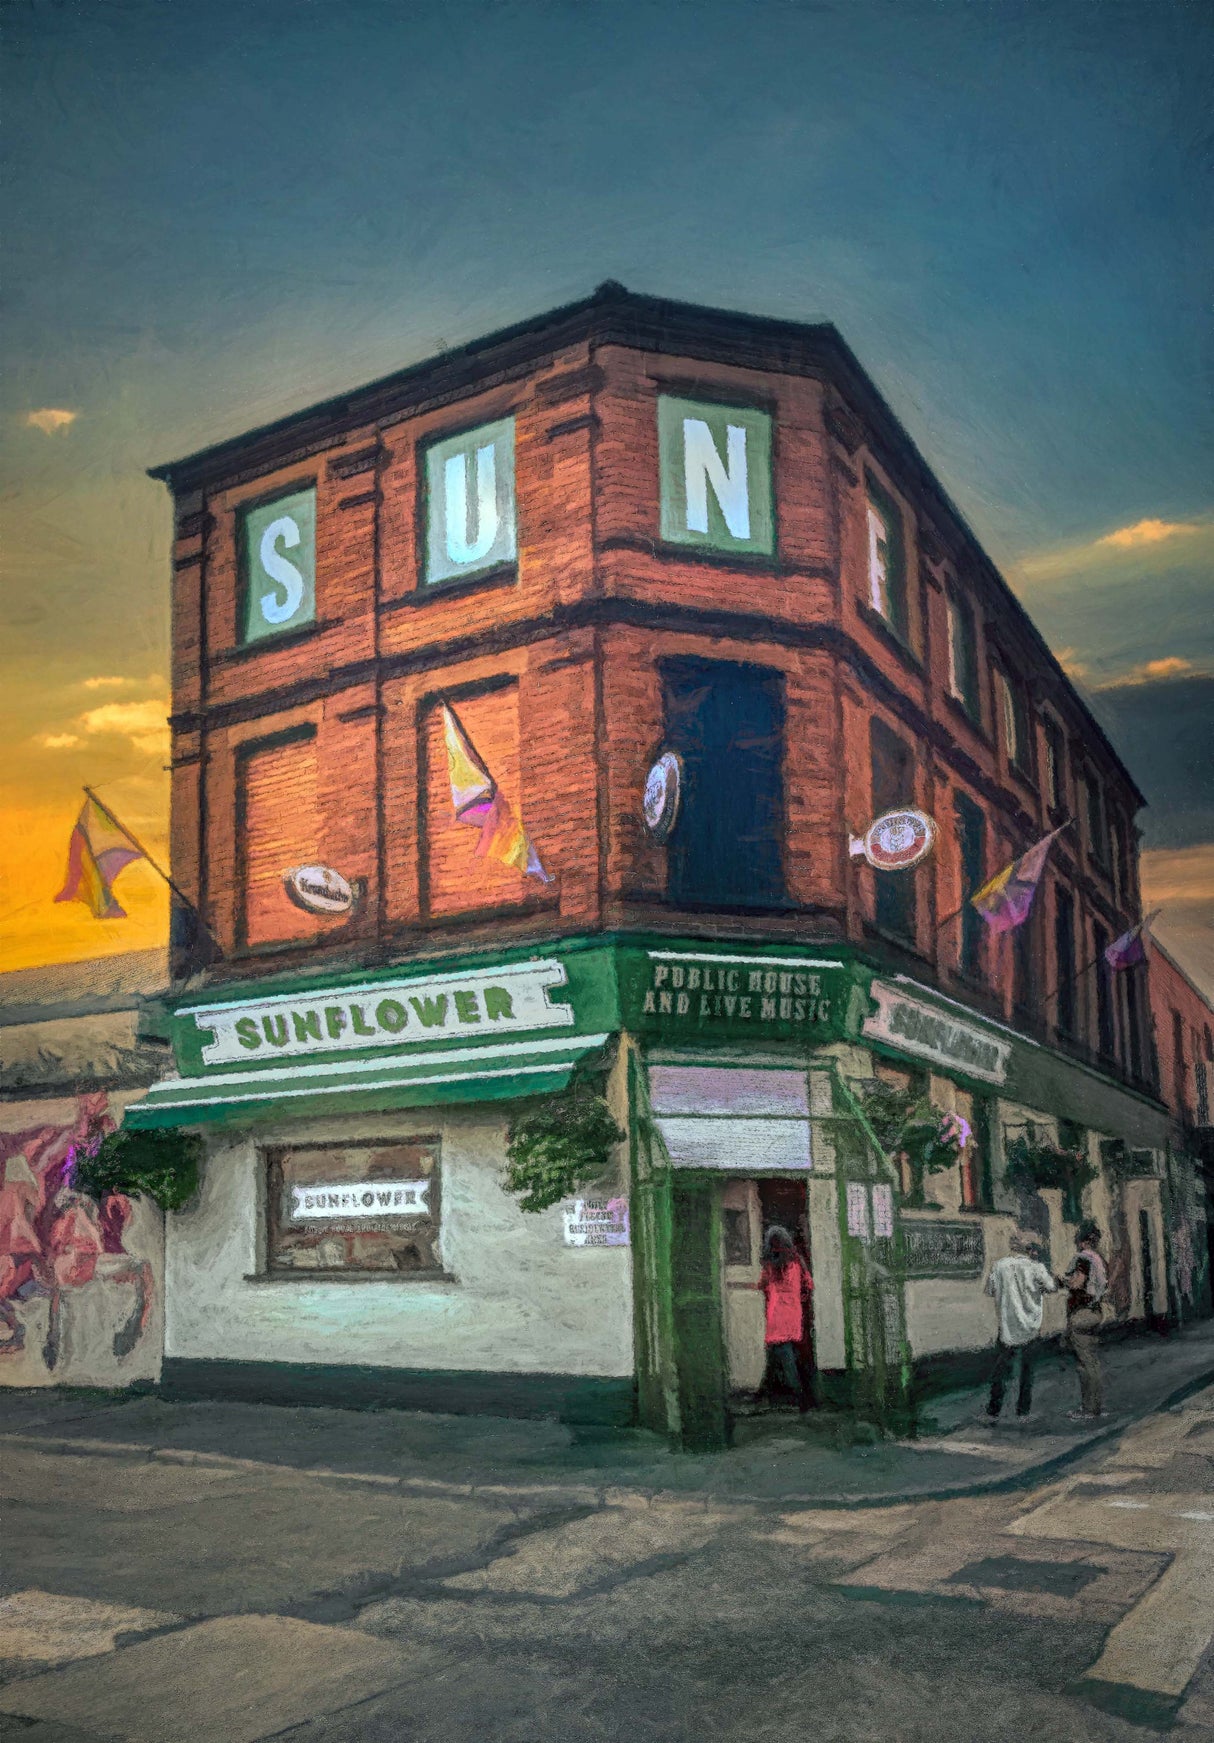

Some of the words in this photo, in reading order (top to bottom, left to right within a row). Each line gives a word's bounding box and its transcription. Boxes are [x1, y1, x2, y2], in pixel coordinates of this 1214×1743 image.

[444, 445, 499, 564] U
[683, 418, 751, 539] N
[260, 515, 304, 625] S
[643, 989, 690, 1016] AND
[701, 994, 752, 1018] LIVE
[761, 997, 832, 1022] MUSIC
[654, 964, 740, 992] PUBLIC
[749, 969, 822, 997] HOUSE
[234, 986, 517, 1050] SUNFLOWER
[304, 1189, 417, 1210] SUNFLOWER
